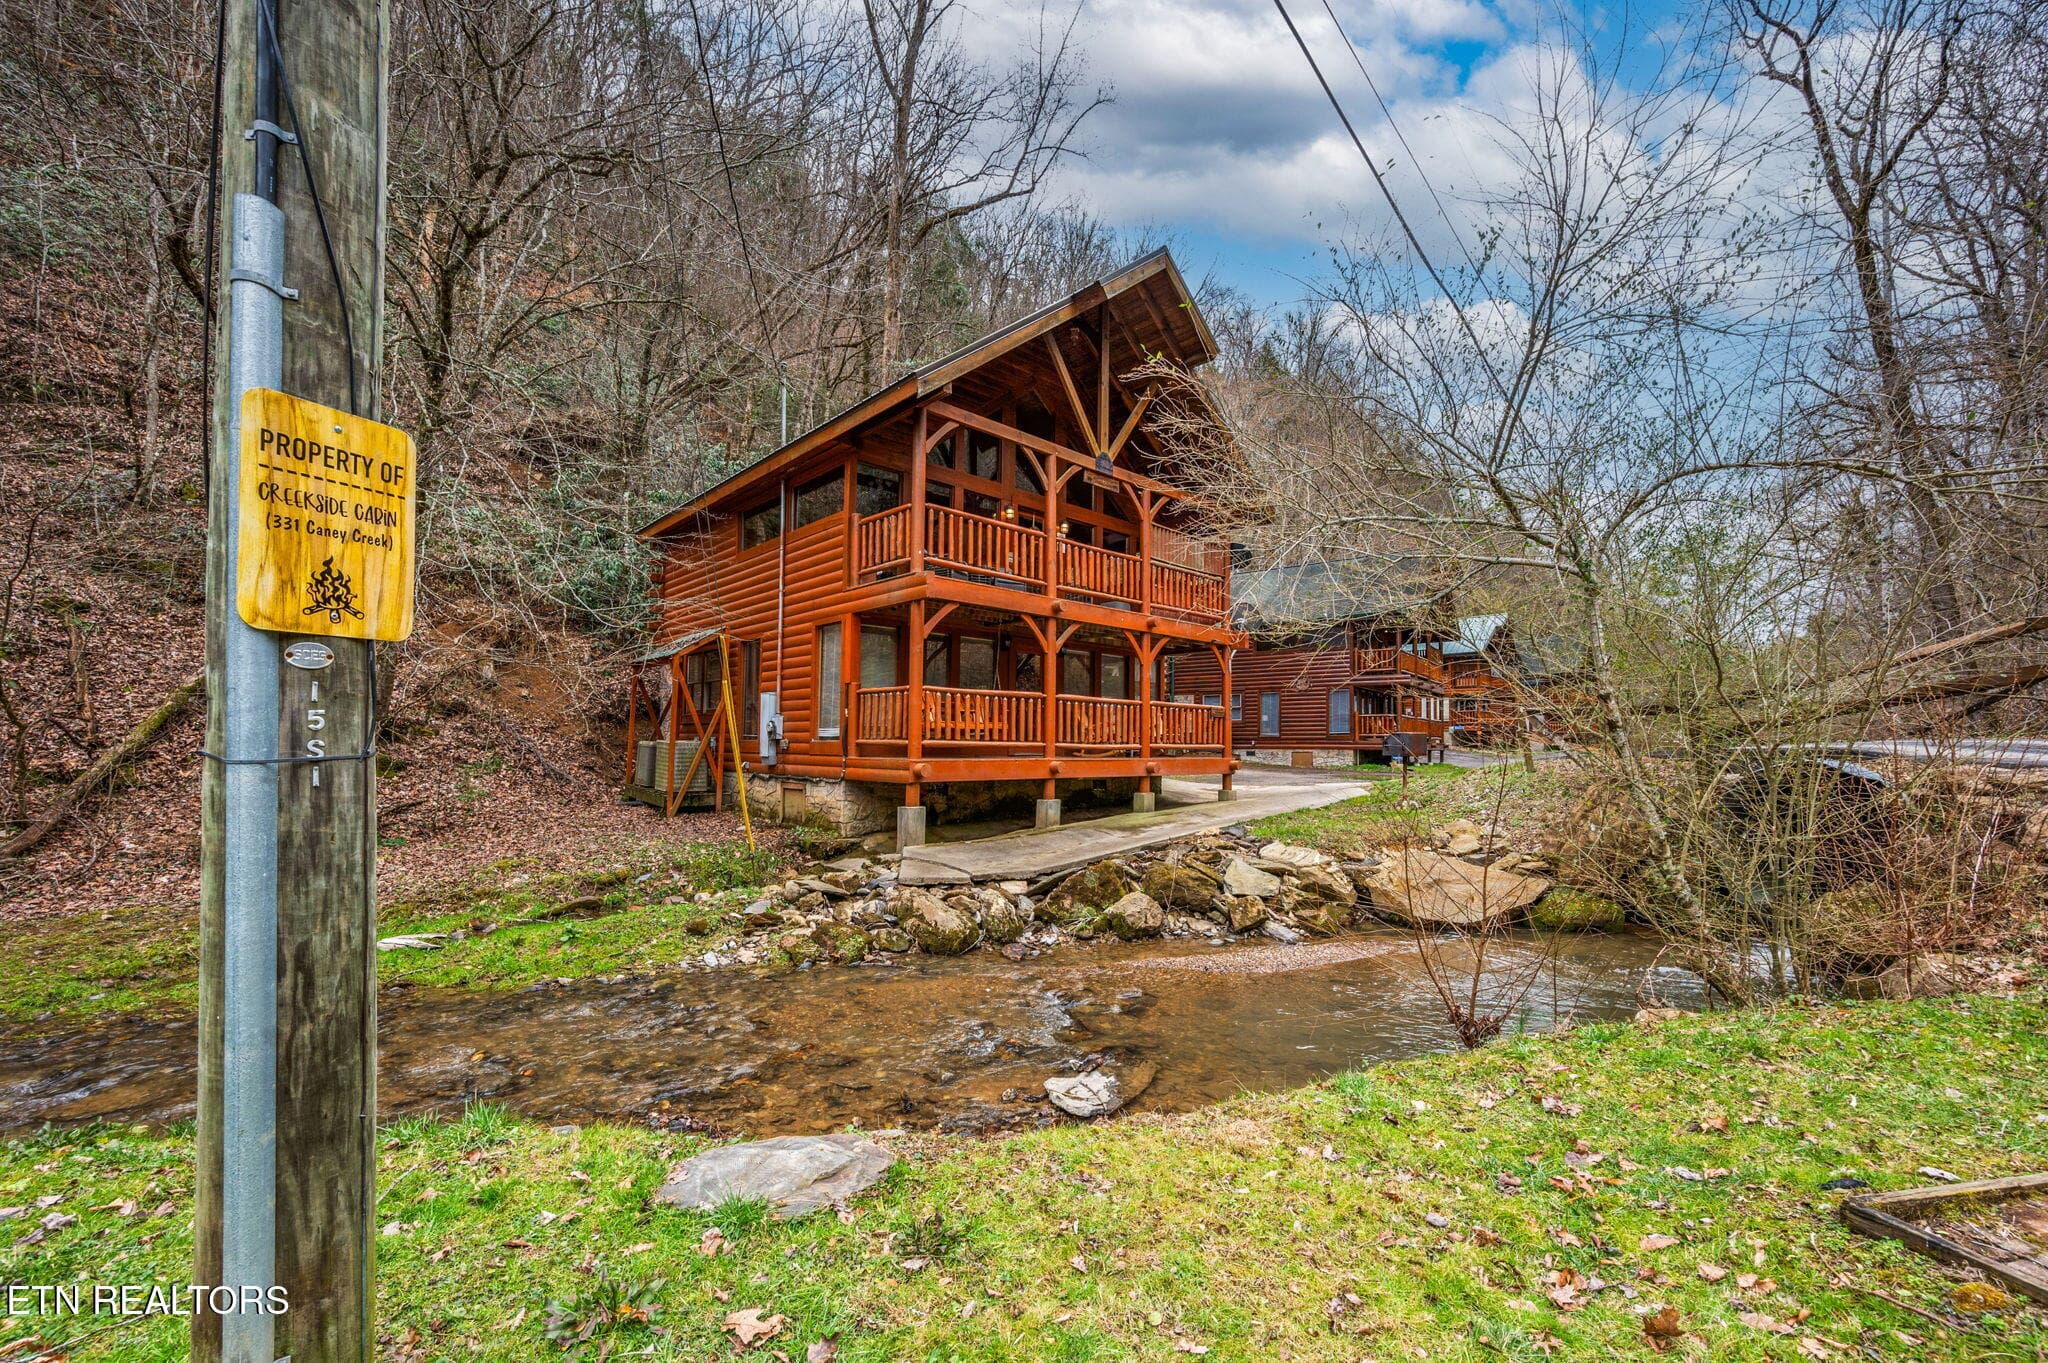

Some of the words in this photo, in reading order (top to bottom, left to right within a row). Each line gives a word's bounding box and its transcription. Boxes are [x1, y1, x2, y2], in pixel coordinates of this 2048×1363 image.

[260, 428, 374, 478] PROPERTY
[380, 461, 405, 486] OF
[258, 481, 349, 518] CREEKSIDE
[354, 503, 397, 528] CABIN
[266, 511, 300, 532] (331
[306, 519, 347, 544] Caney
[352, 528, 394, 552] Creek)
